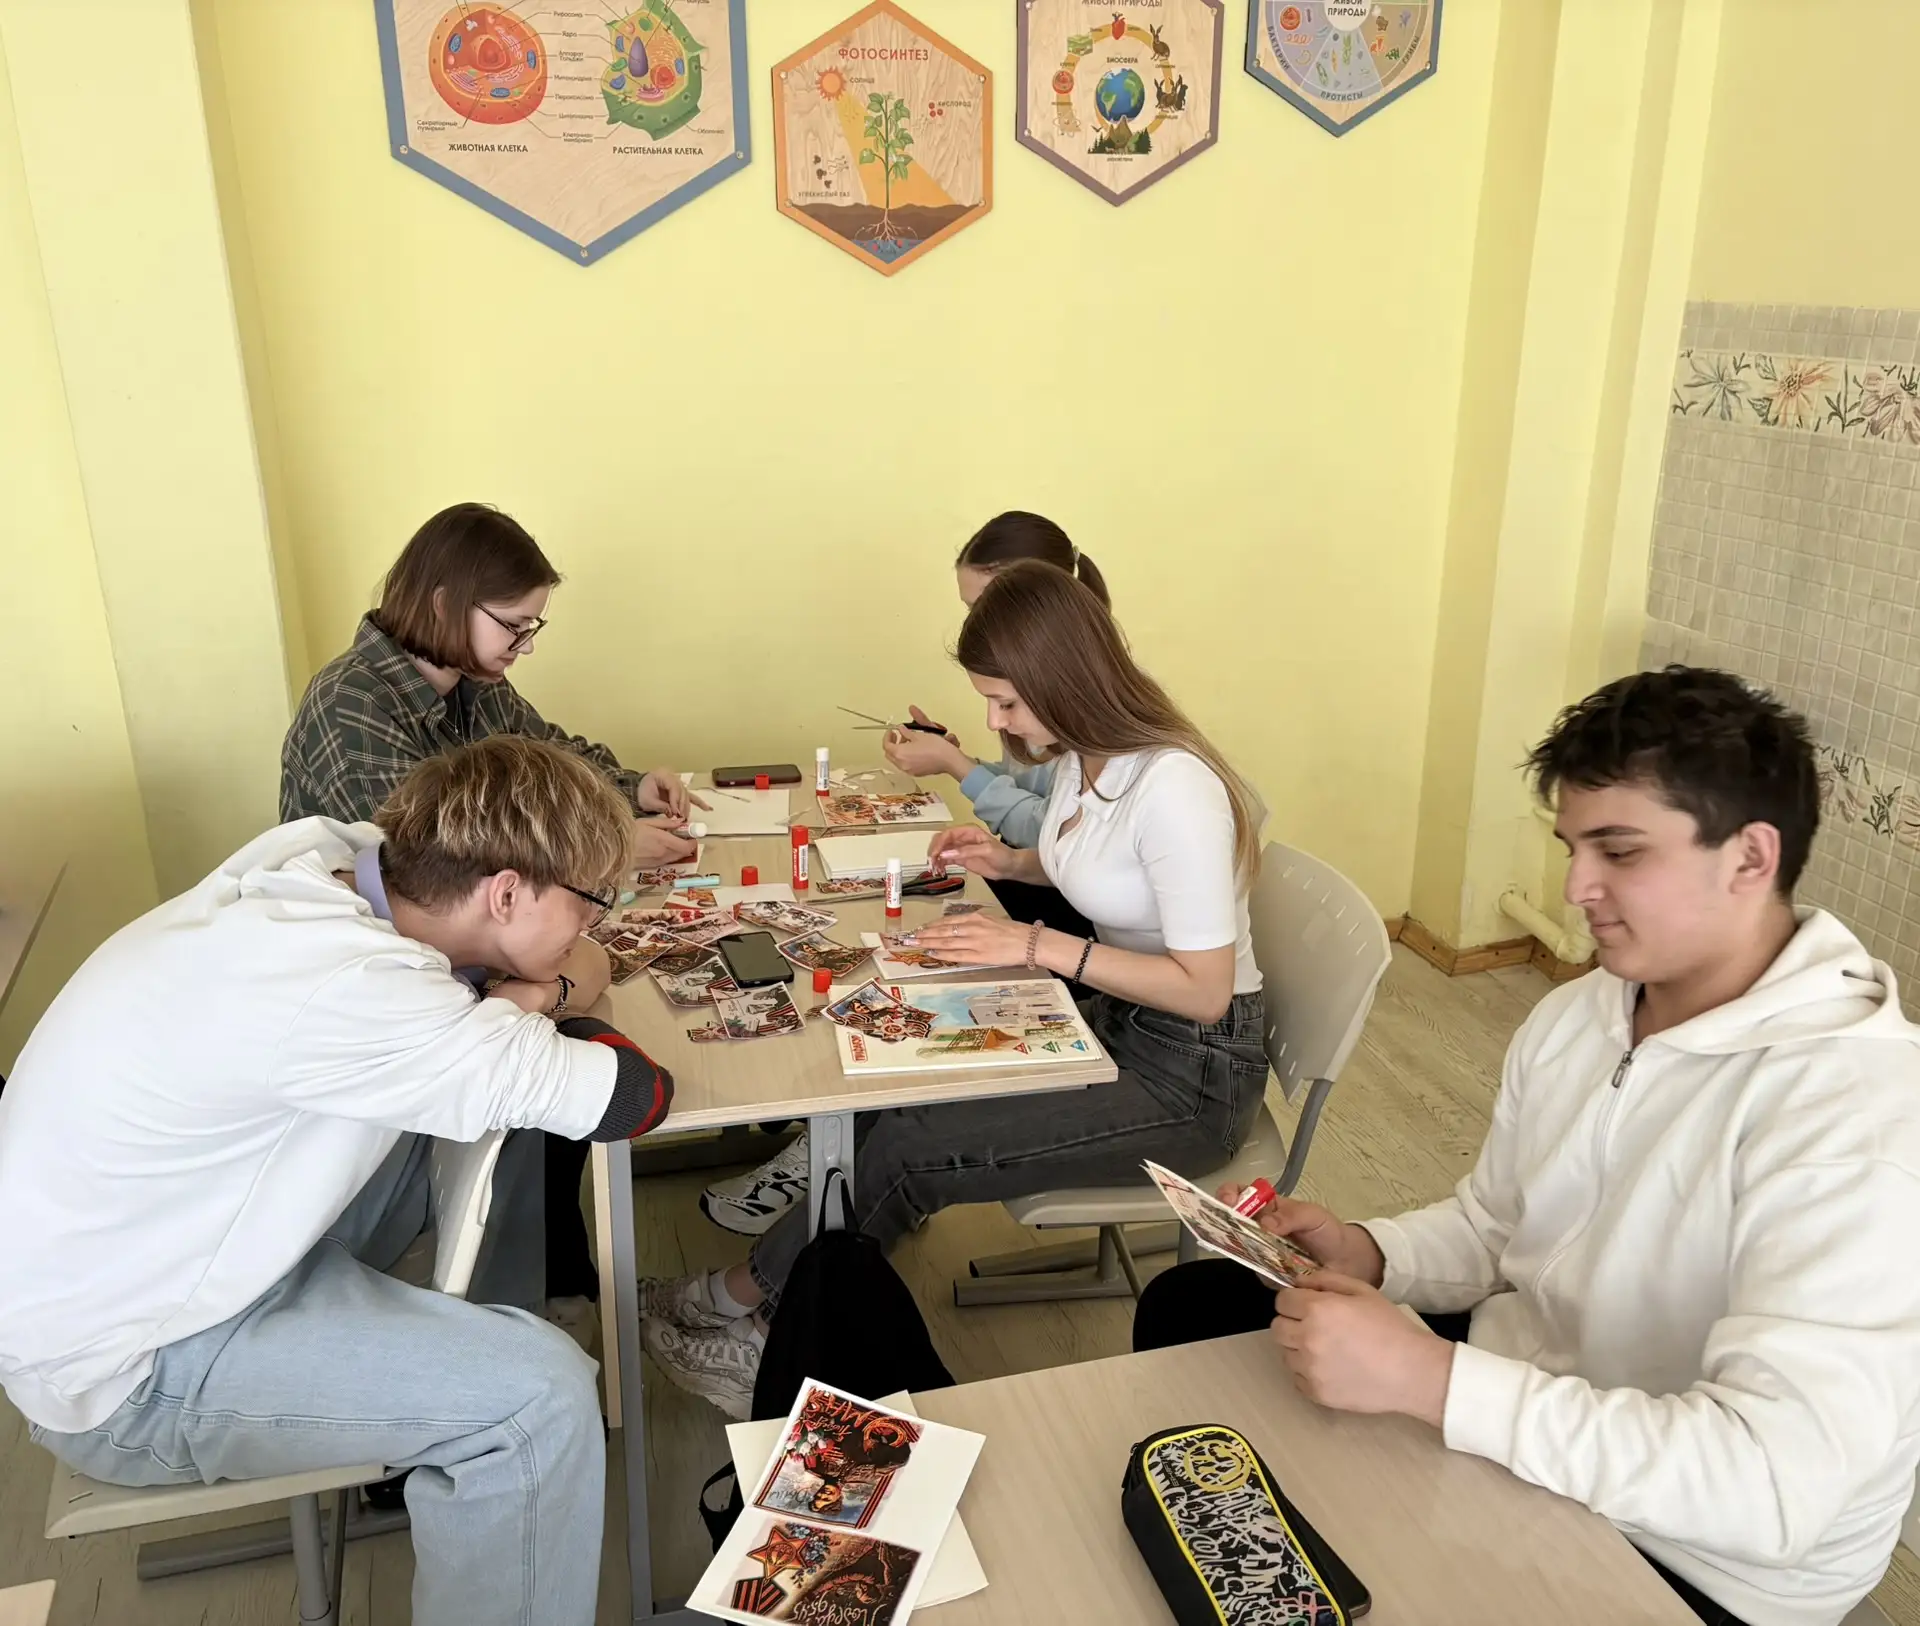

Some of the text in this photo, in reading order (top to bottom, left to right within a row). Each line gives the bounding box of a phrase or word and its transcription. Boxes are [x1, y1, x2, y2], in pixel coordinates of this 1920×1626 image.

[1327, 7, 1367, 17] ПРИРОДЫ
[1267, 25, 1291, 71] БАКТЕРИИ
[838, 48, 929, 61] ФОТОСИНТЕЗ
[1320, 90, 1364, 102] ПРОТИСТЫ
[448, 143, 529, 153] ЖИВОТНАЯ КЛЕТКА
[612, 146, 704, 156] РАСТИТЕЛЬНАЯ КЛЕТКА
